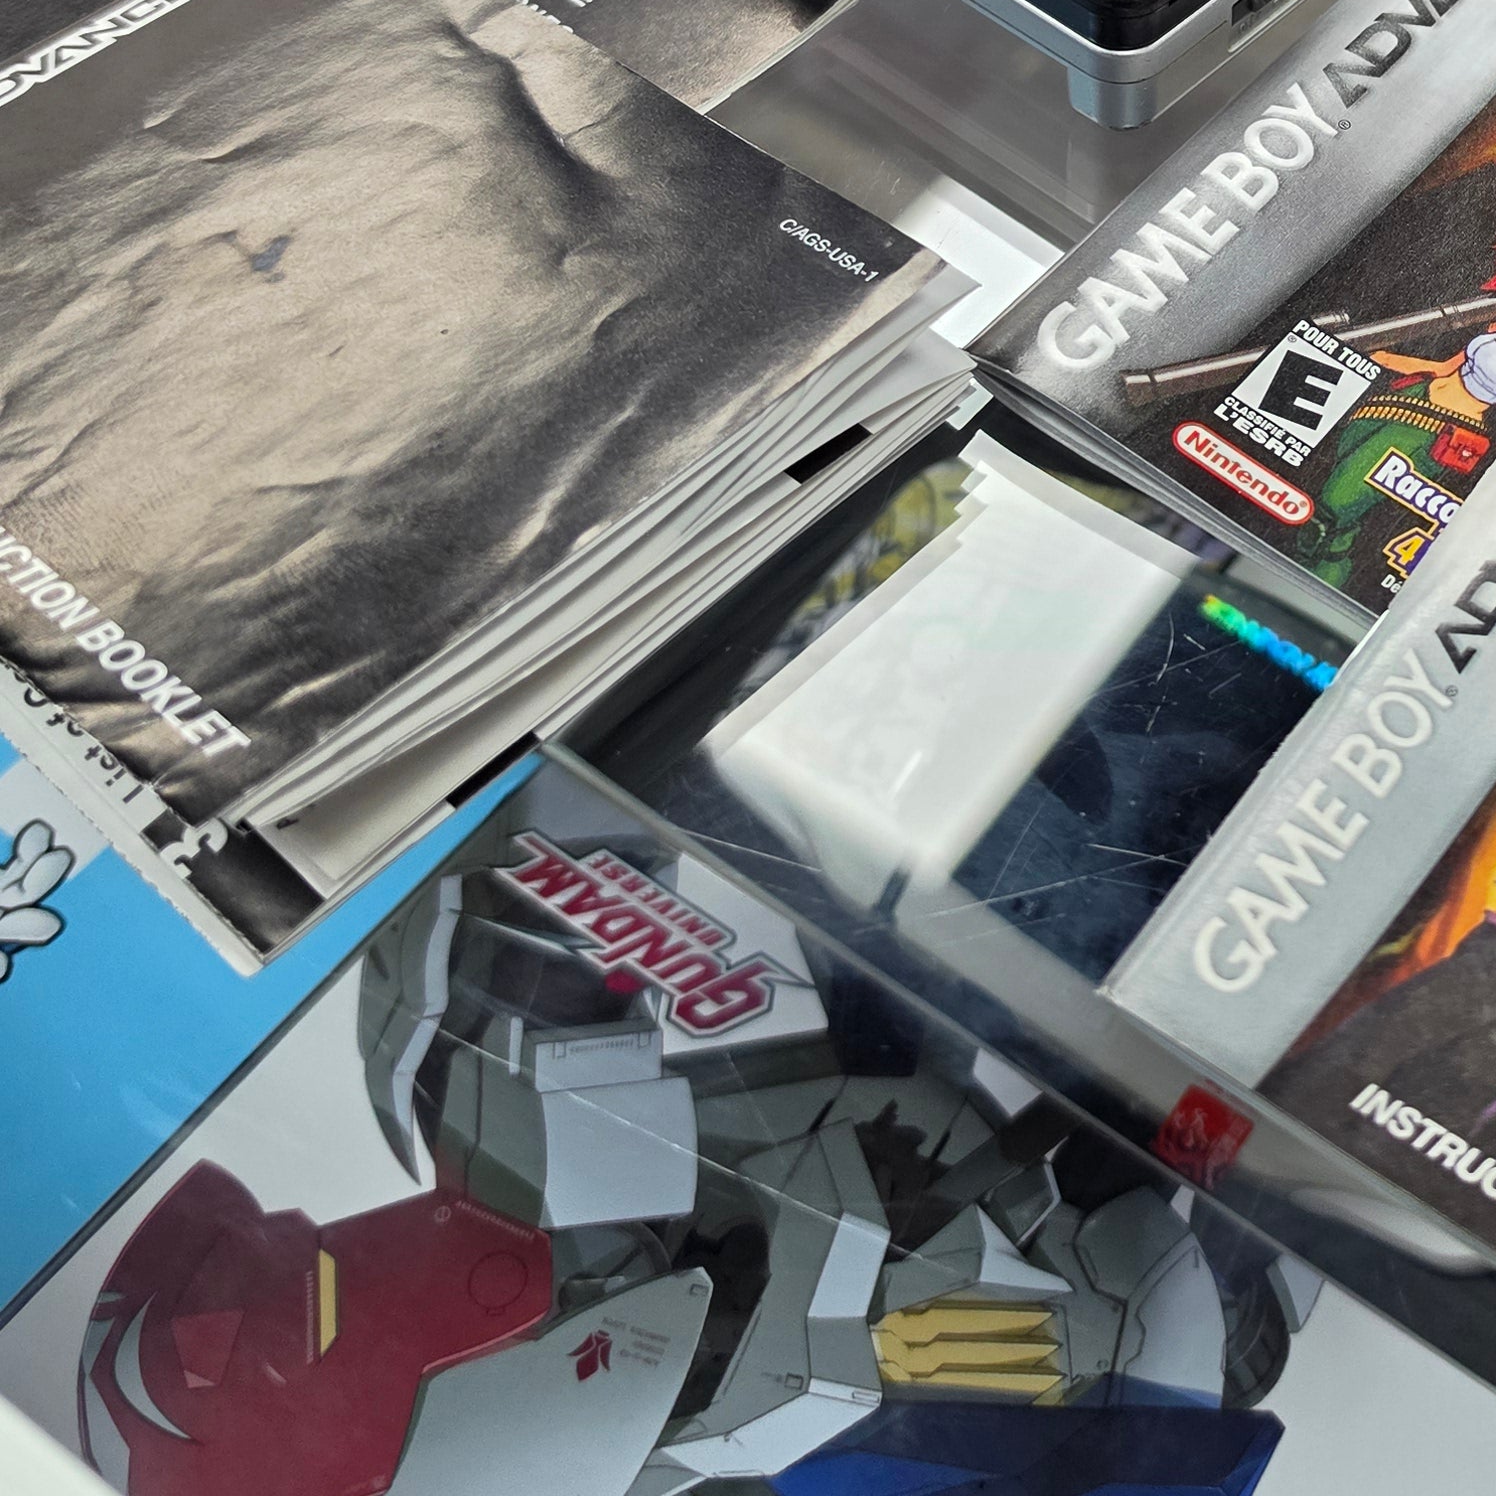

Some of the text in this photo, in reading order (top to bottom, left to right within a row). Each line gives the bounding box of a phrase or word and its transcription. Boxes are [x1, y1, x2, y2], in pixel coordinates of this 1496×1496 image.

[779, 218, 878, 282] C/AGS-USA-1
[1037, 187, 1240, 371] GAME
[1201, 81, 1340, 213] BOY
[1257, 349, 1348, 432] E
[1291, 318, 1383, 382] POUR TOUS
[1213, 402, 1305, 469] L'ESRB
[1223, 396, 1312, 458] CLASSIFIÉ PAR
[1182, 428, 1304, 518] Nintendo
[1394, 534, 1426, 566] 4
[76, 618, 252, 758] BOOKLET
[1193, 781, 1370, 993] GAME
[1333, 649, 1457, 798] BOY
[512, 832, 779, 1034] GUNDAM
[590, 853, 723, 954] UNIVERSE
